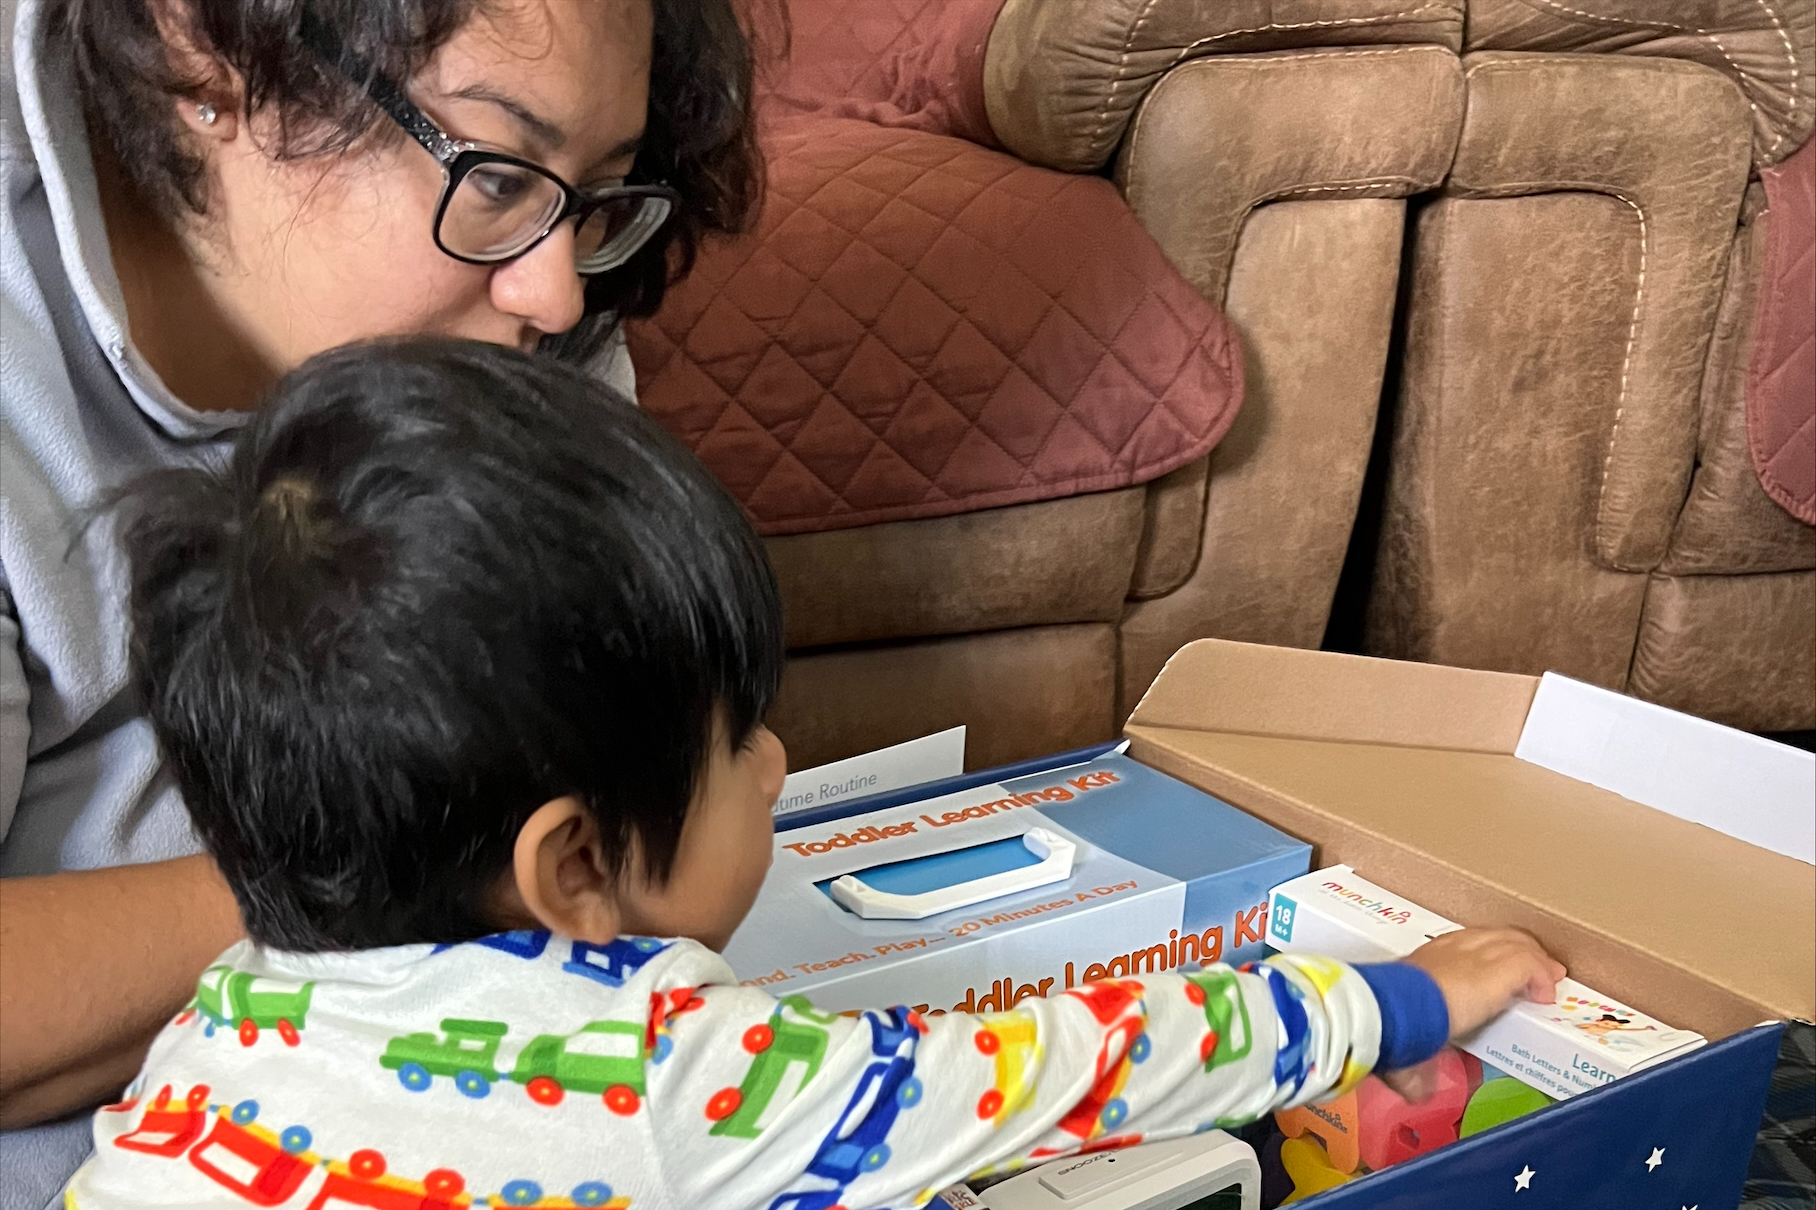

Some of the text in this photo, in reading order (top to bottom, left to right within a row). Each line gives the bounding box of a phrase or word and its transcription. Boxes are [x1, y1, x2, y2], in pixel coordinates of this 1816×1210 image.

[819, 774, 877, 800] Routine
[783, 771, 1121, 857] Toddler Learning Kit
[1275, 904, 1292, 925] 18
[1321, 881, 1412, 925] munchkin
[793, 952, 876, 975] Teach.
[949, 922, 981, 938] 20
[979, 898, 1074, 926] Minutes
[1074, 893, 1096, 903] A
[1092, 880, 1138, 896] Day
[1234, 902, 1267, 948] Ki
[1274, 924, 1289, 937] M+
[1486, 1045, 1514, 1067] Lettres
[1515, 1062, 1524, 1073] et
[1525, 1066, 1556, 1088] chiffres
[1511, 1043, 1597, 1090] Bath Letters & Num
[1572, 1053, 1616, 1083] Learn
